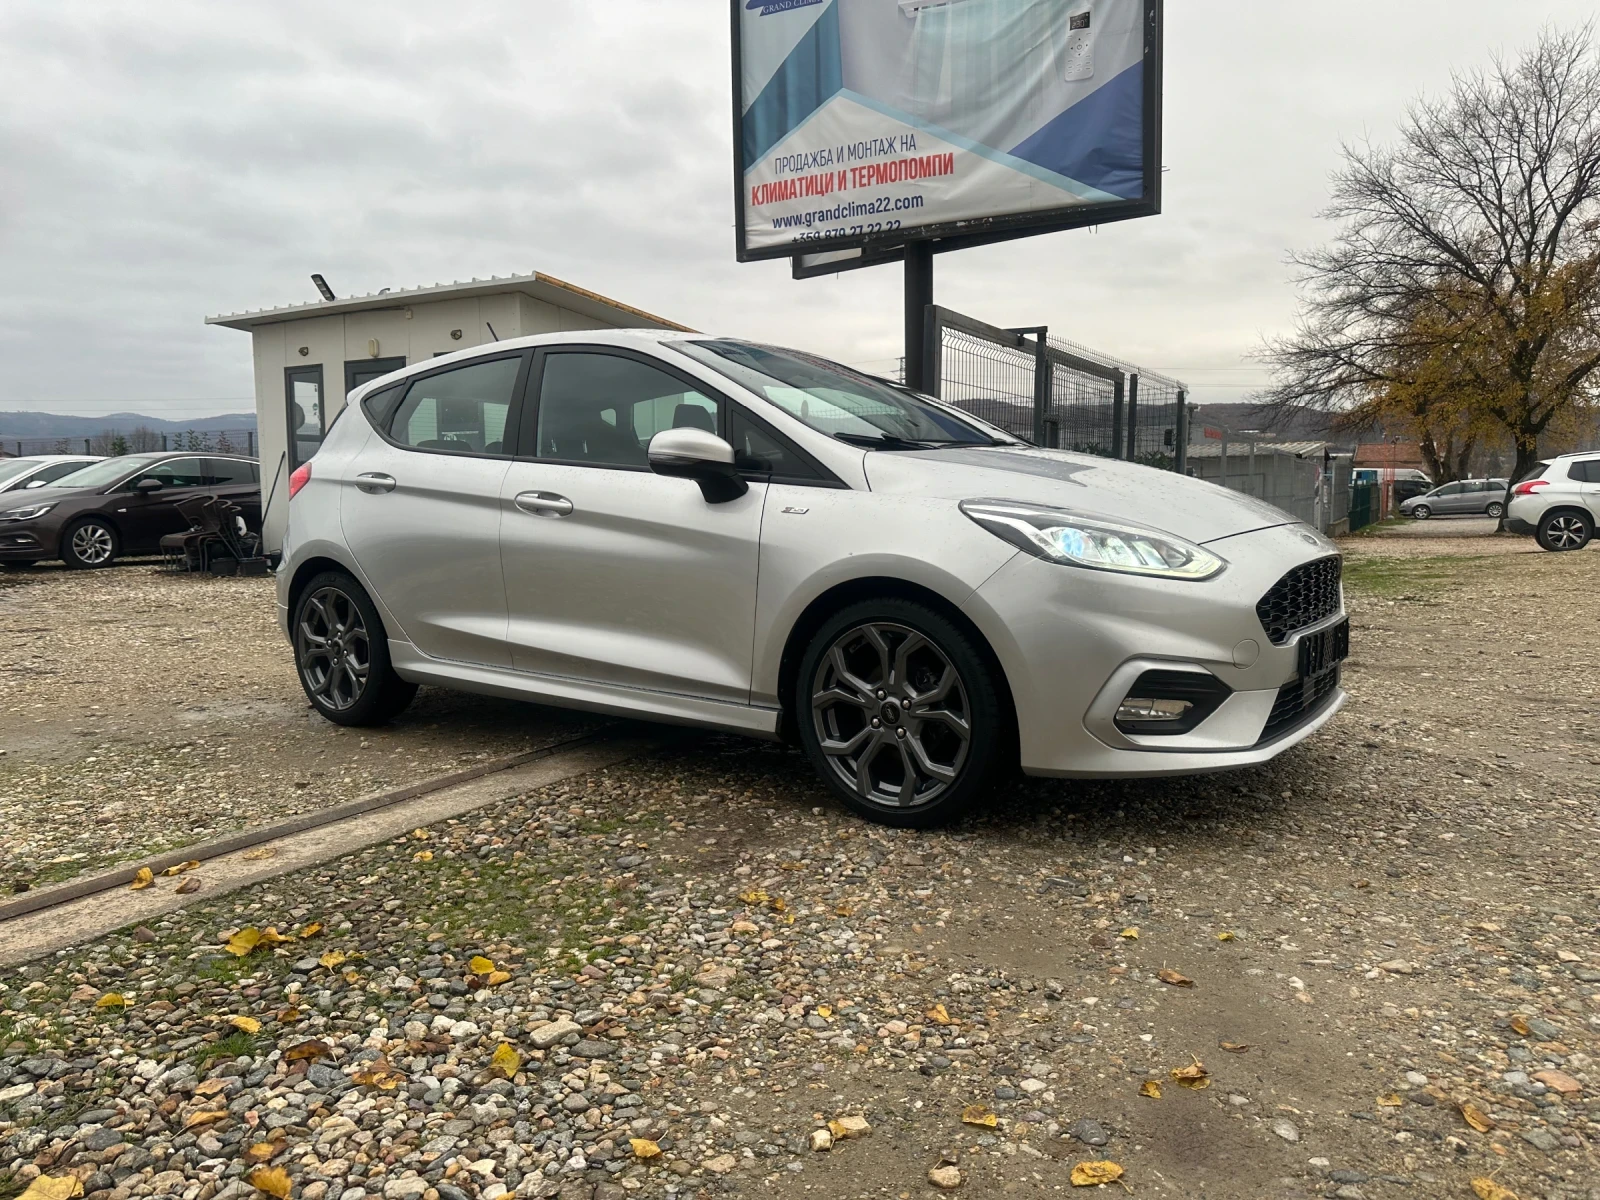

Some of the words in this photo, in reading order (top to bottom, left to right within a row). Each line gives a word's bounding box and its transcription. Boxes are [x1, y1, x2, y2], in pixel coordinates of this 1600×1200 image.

[763, 1, 791, 14] GRAND
[774, 149, 834, 175] ПРОДАЖБА
[836, 146, 845, 164] И
[847, 136, 897, 161] МОНТАЖ
[900, 133, 917, 151] НА
[751, 172, 834, 207] КЛИМАТИЦИ
[837, 169, 847, 193] И
[850, 152, 954, 189] ТЕРМОПОМПИ
[772, 194, 924, 229] www.grandclima22.com
